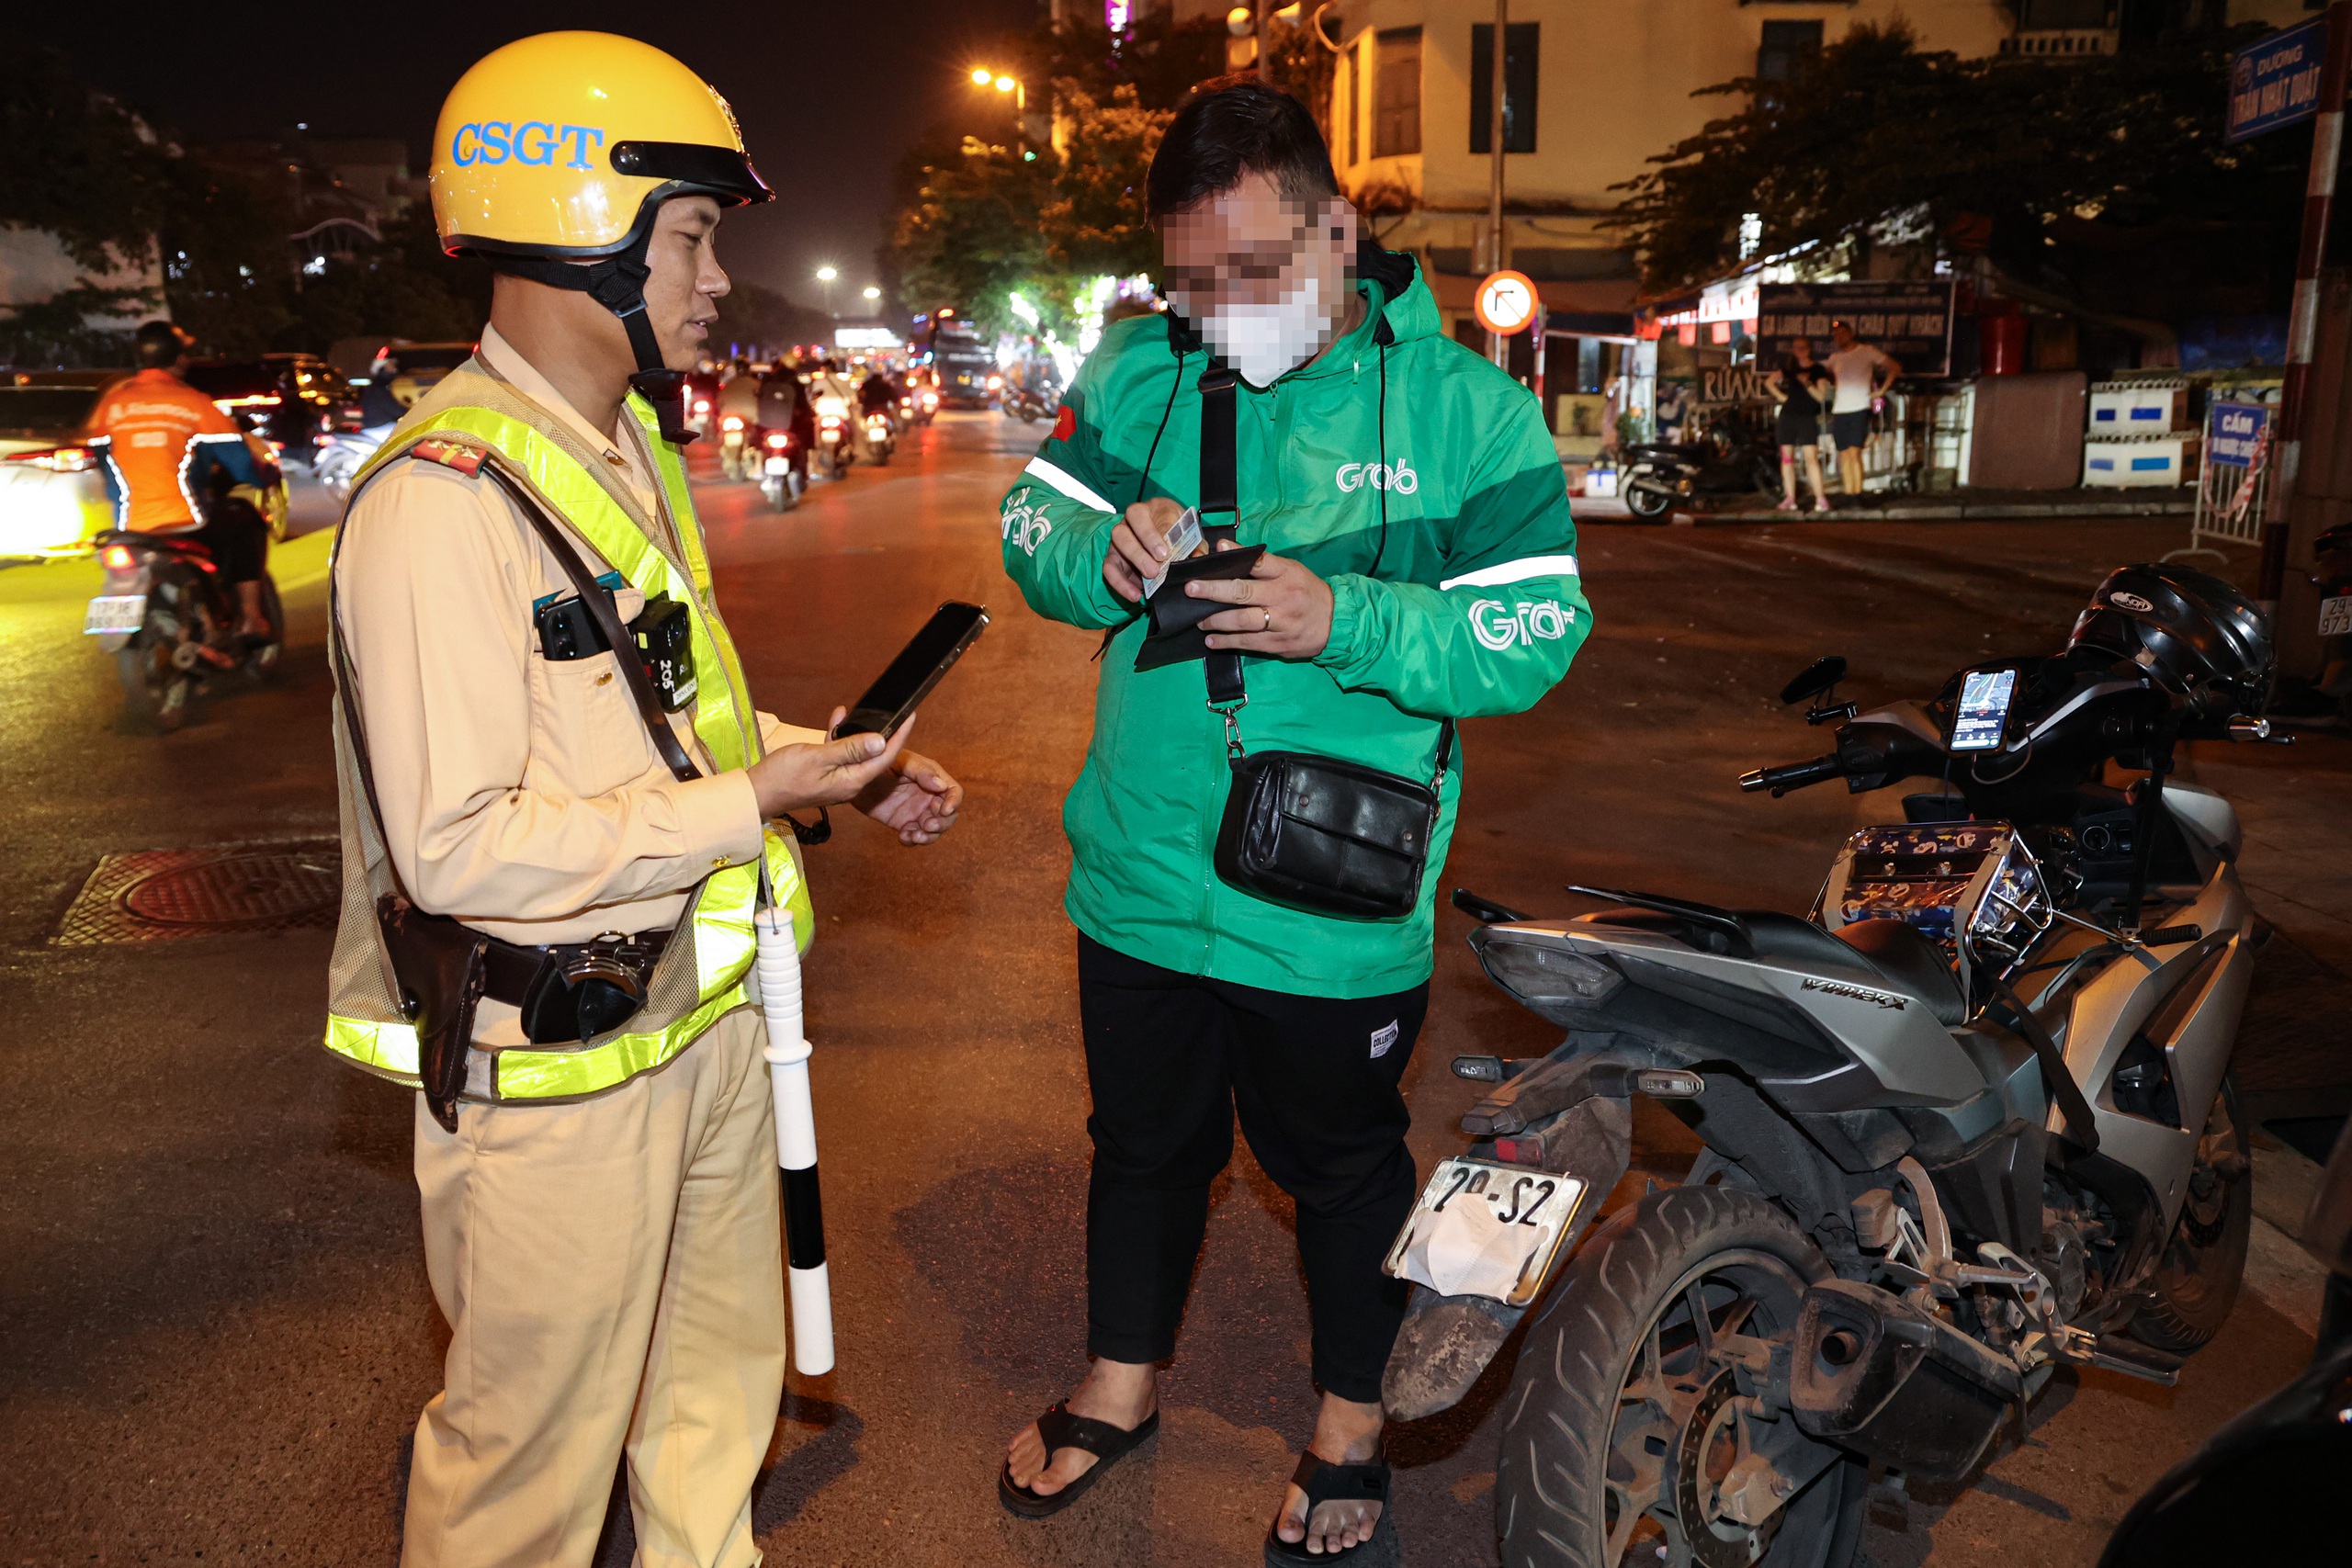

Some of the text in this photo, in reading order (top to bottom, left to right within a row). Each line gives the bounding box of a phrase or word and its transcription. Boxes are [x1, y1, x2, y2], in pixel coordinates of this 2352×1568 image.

[452, 120, 604, 170] CSGT
[1336, 457, 1418, 495] Grab
[660, 660, 675, 693] 205
